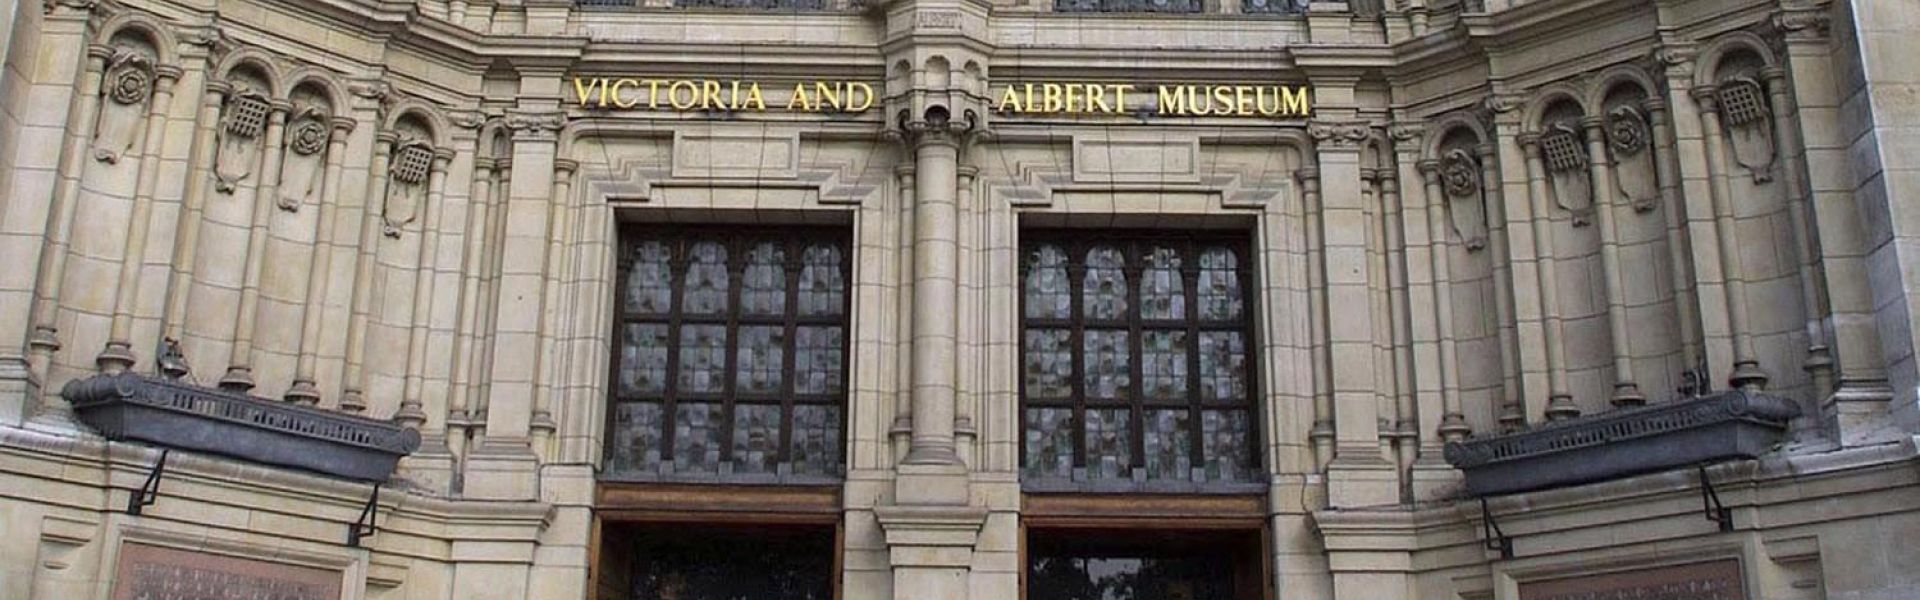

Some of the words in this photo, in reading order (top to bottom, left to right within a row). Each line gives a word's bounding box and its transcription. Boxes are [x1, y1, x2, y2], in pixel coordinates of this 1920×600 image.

[573, 77, 767, 109] VICTORIA
[788, 81, 874, 113] AND
[998, 83, 1135, 114] ALBERT
[1158, 85, 1310, 116] MUSEUM
